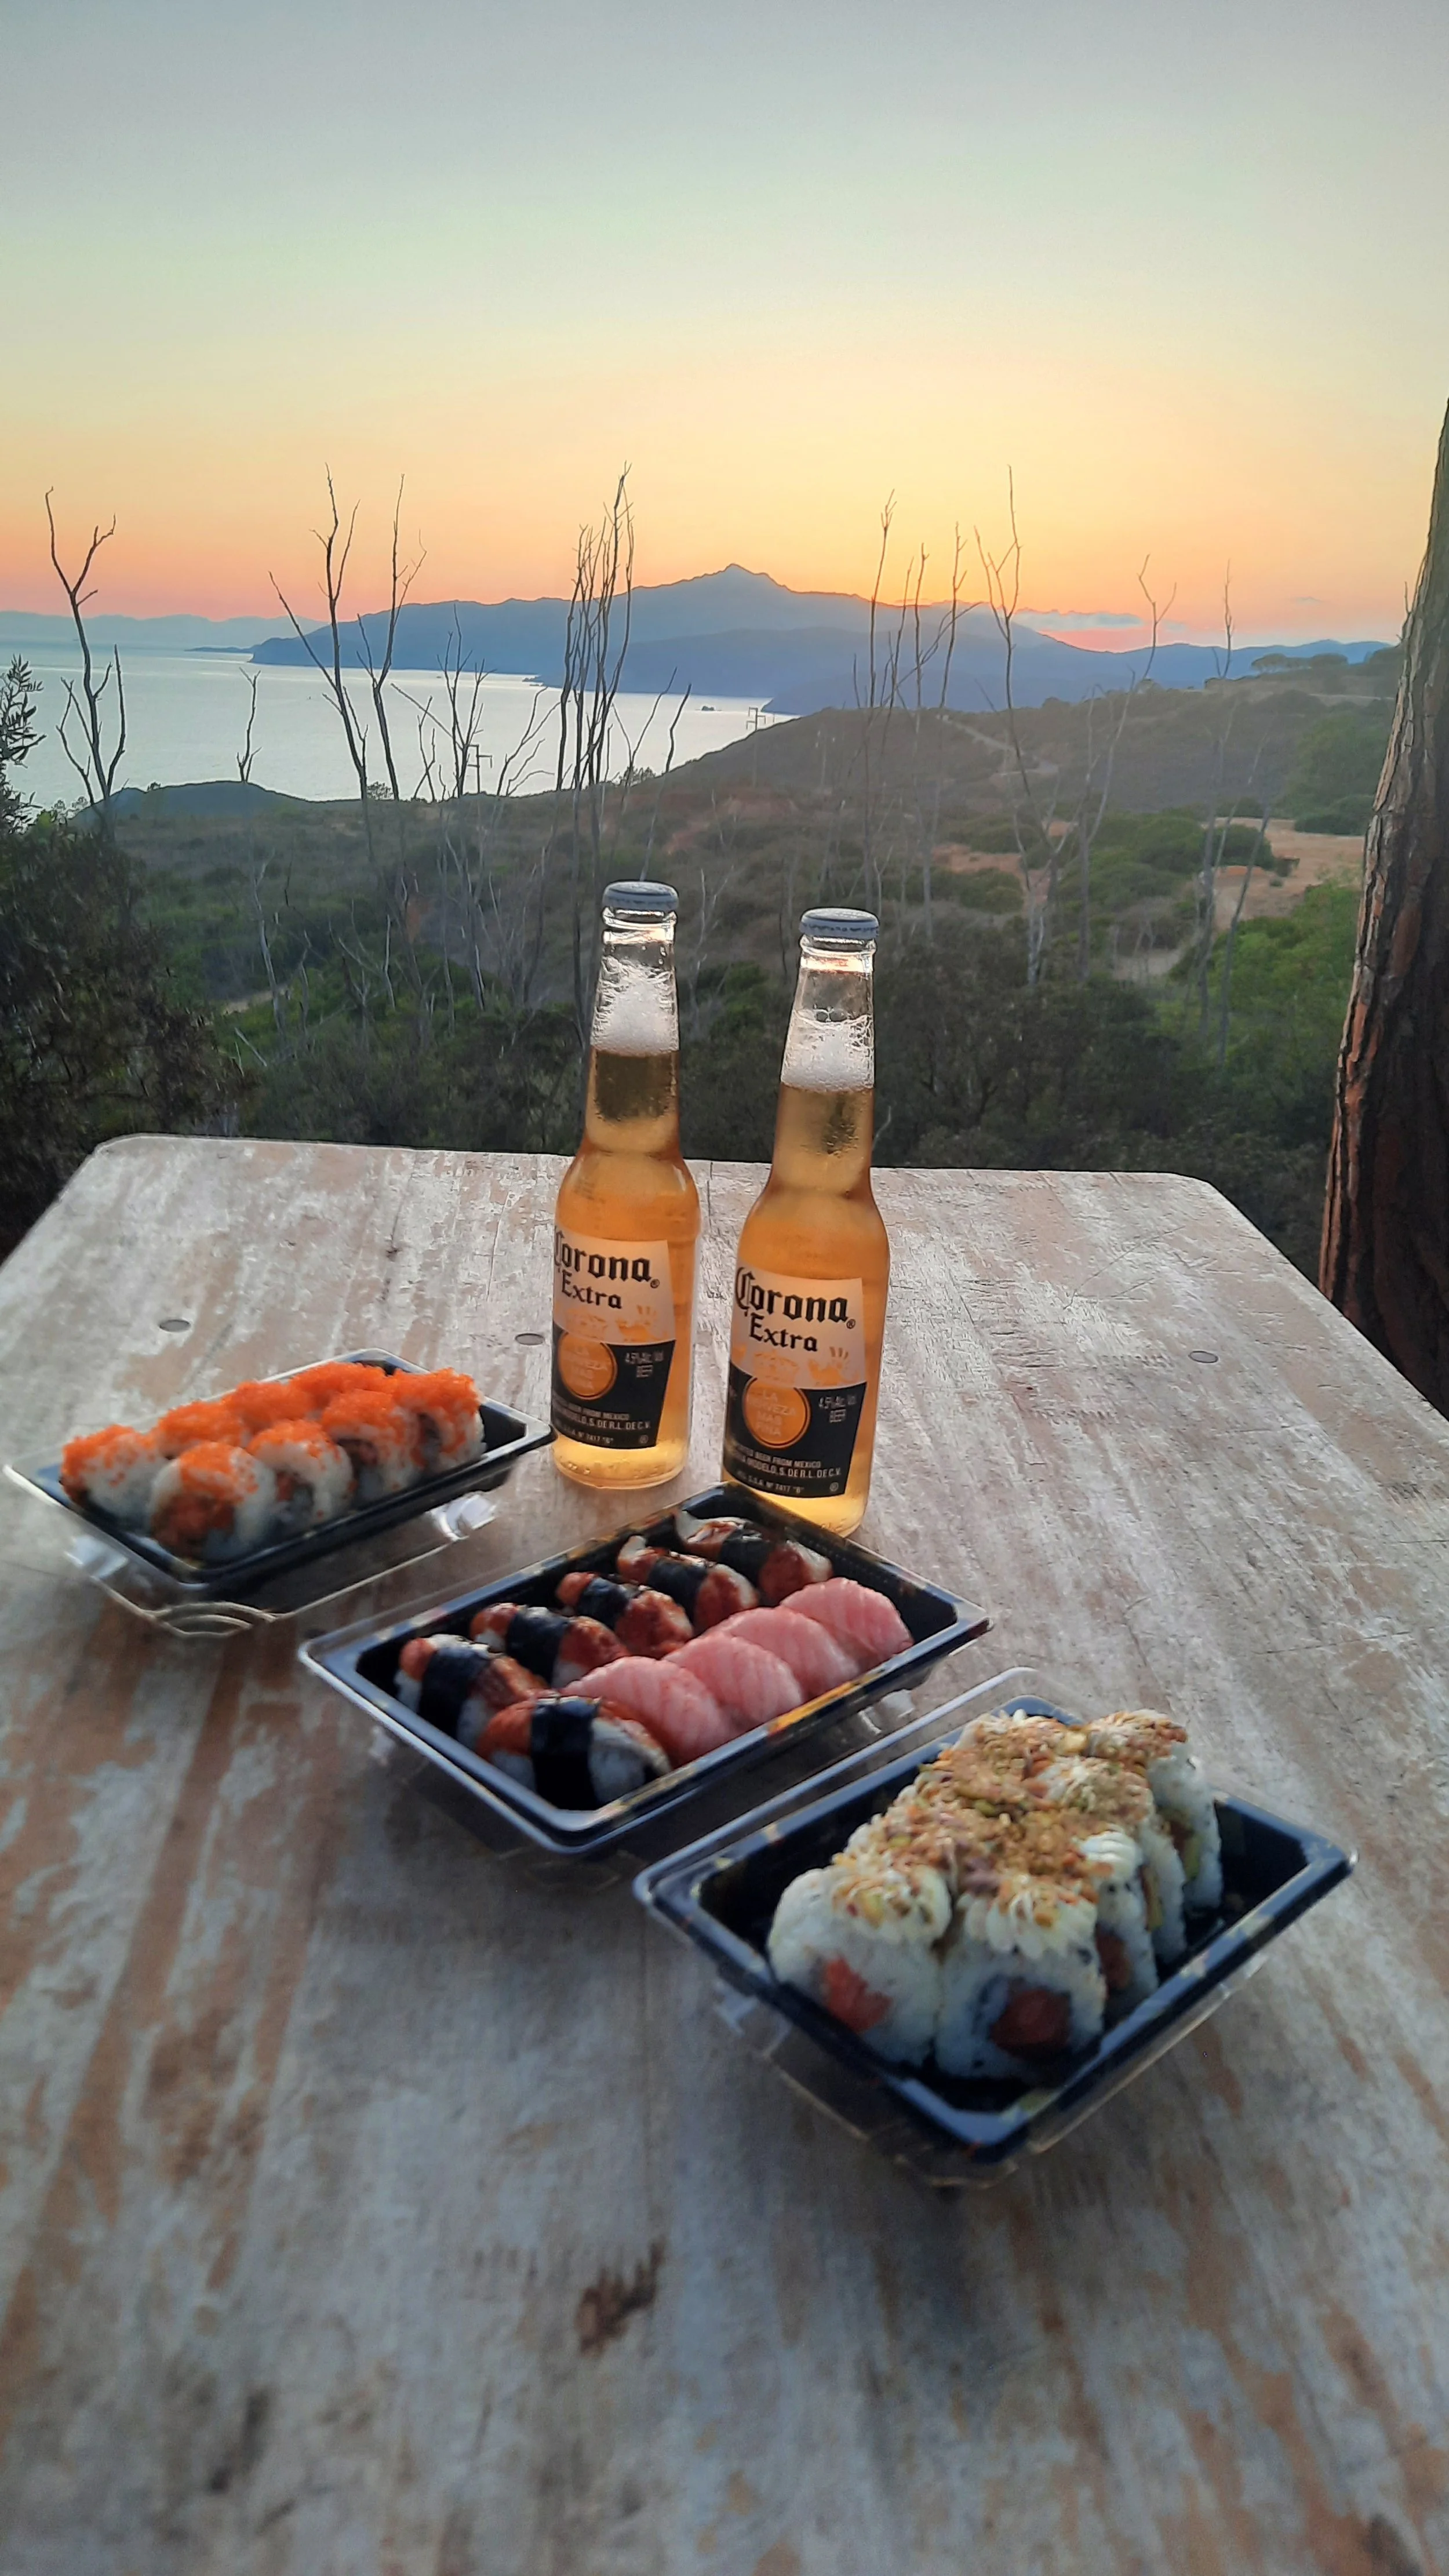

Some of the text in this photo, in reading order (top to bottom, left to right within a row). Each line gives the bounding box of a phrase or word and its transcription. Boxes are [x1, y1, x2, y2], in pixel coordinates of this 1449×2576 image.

[554, 1227, 651, 1282] Corona
[561, 1268, 622, 1309] Extra
[736, 1267, 849, 1323] Corona
[749, 1312, 818, 1352] Extra
[598, 1420, 607, 1428] DE
[625, 1421, 636, 1430] DE
[772, 1456, 793, 1467] FROM
[793, 1460, 821, 1469] MEXICO
[788, 1468, 799, 1477] DE
[817, 1468, 828, 1478] DE
